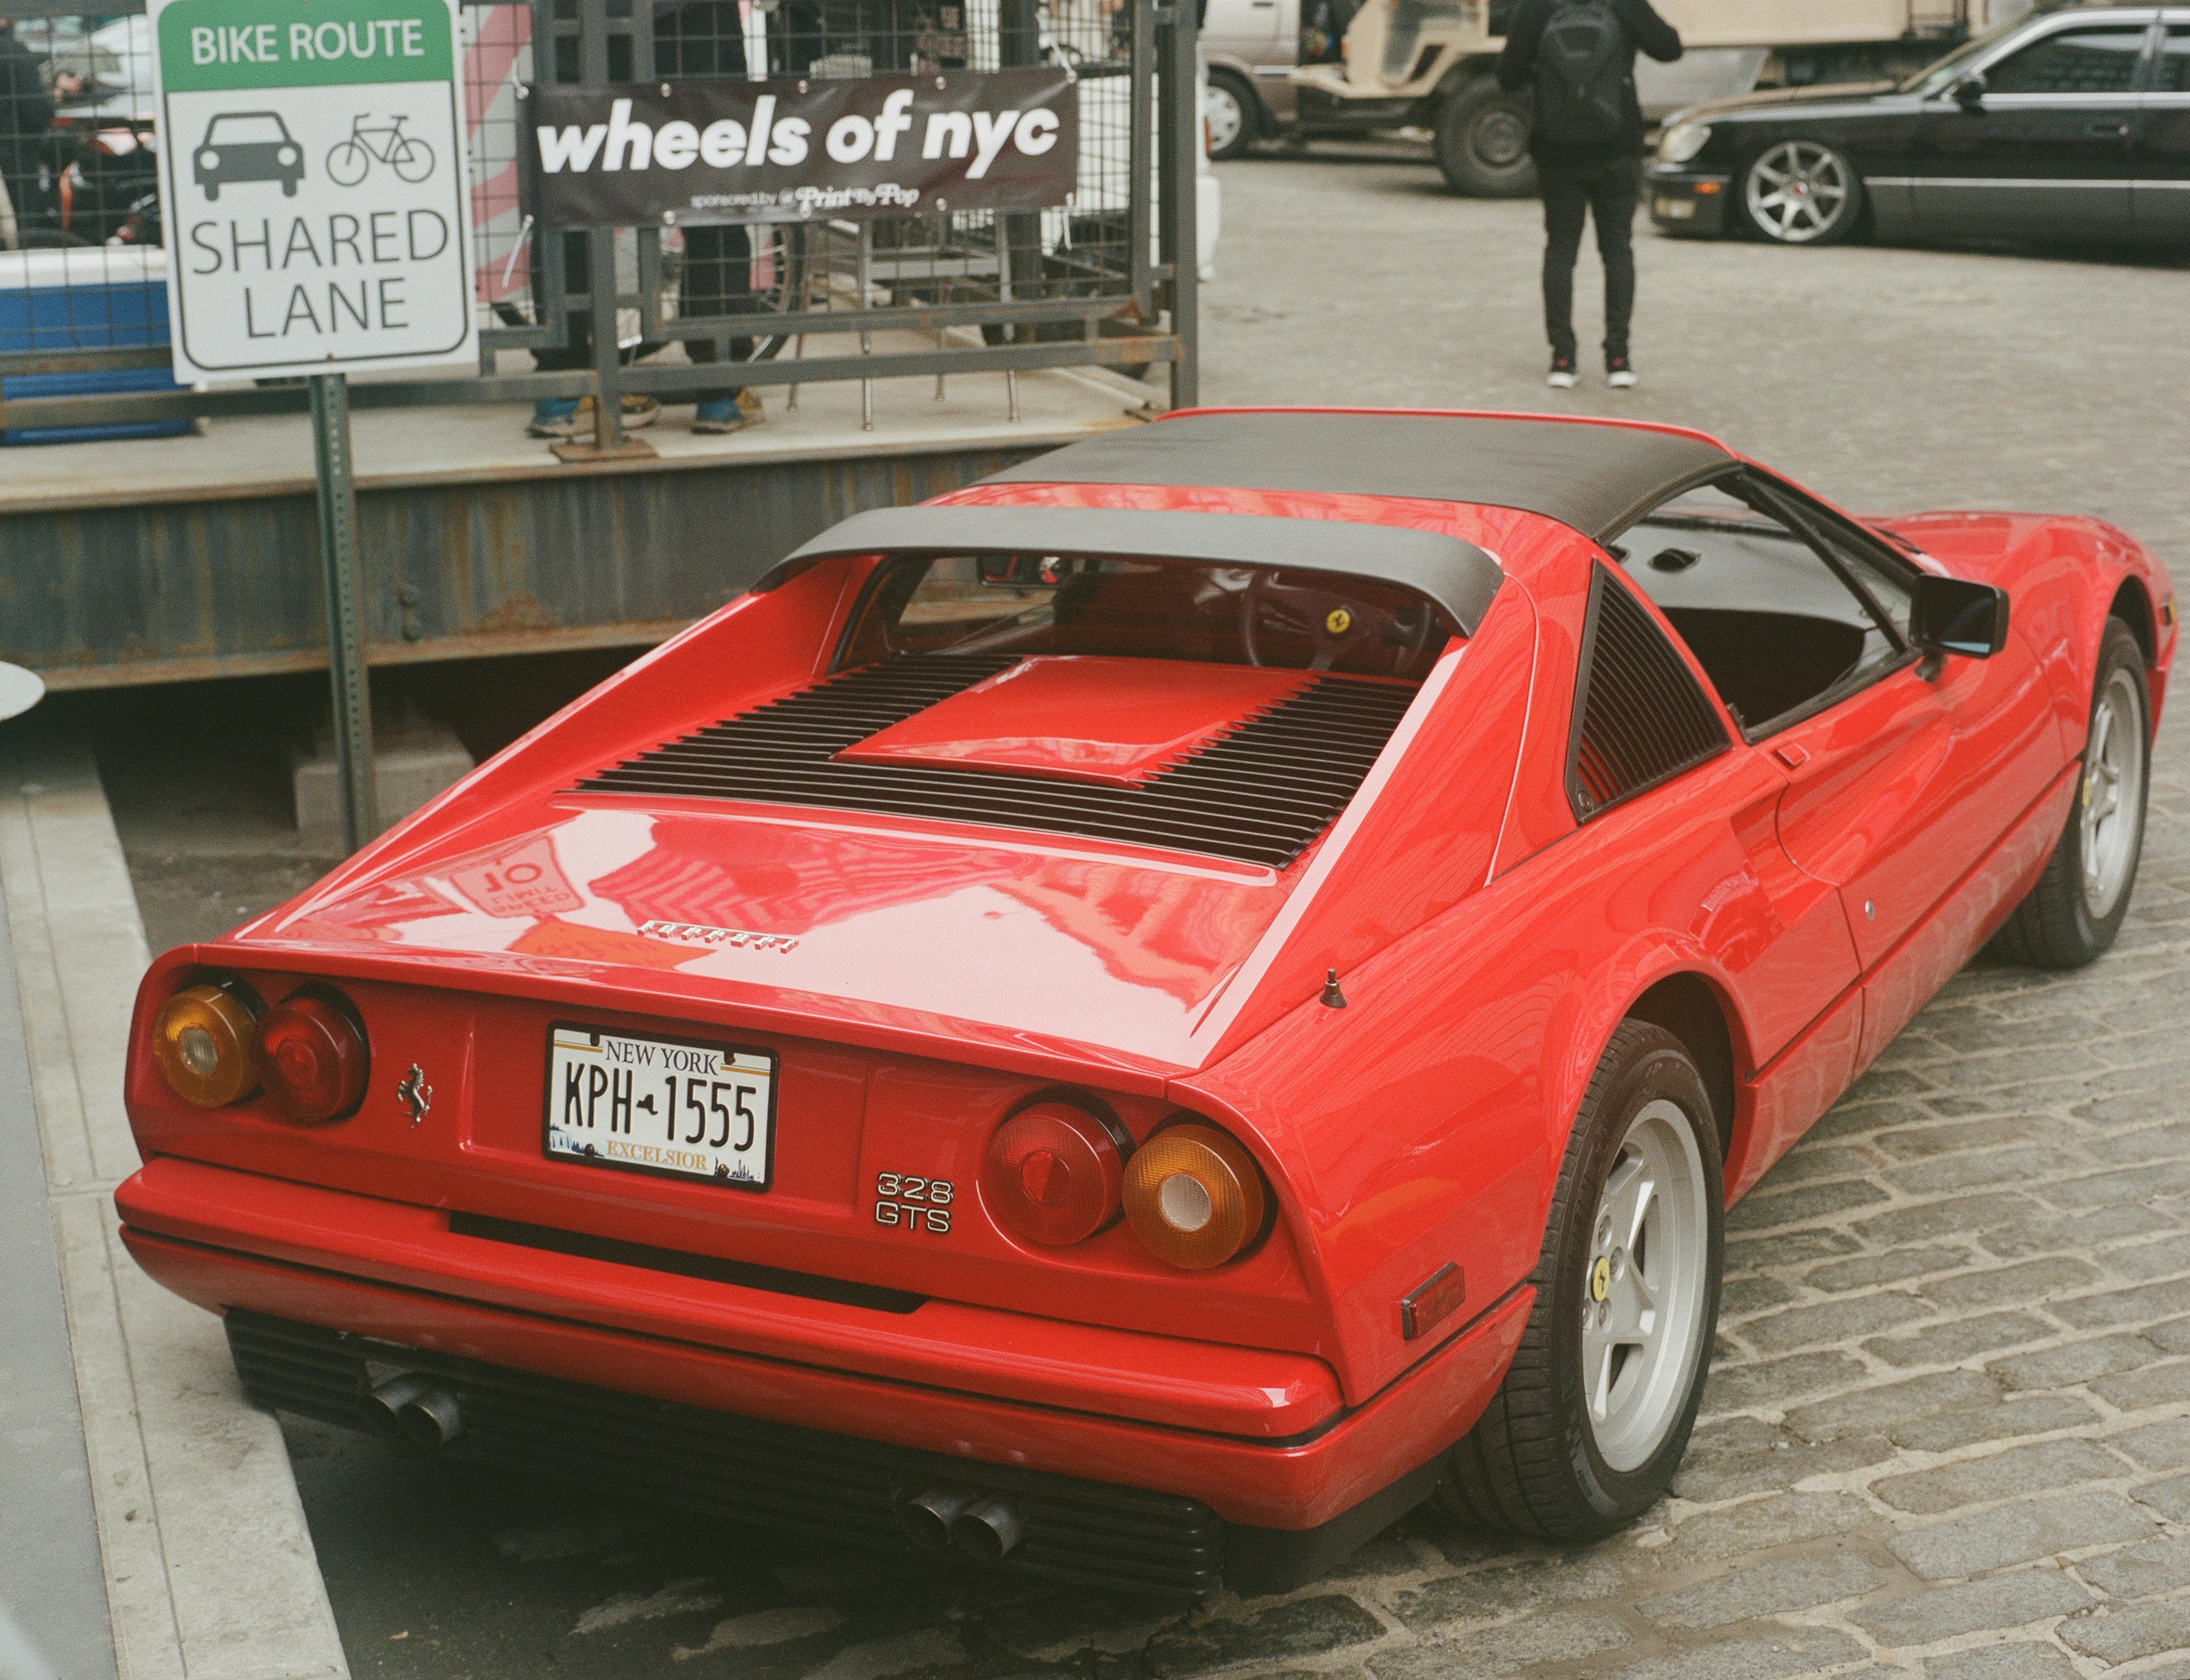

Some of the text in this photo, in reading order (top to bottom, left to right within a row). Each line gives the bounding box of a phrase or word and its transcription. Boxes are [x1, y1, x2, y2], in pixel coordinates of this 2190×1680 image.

[191, 18, 425, 65] BIKE ROUTE
[537, 89, 1060, 179] wheels of nyc
[191, 209, 448, 275] SHARED
[244, 278, 409, 338] LANE
[606, 1040, 719, 1076] NEW YORK
[564, 1061, 757, 1153] KPH 1555
[606, 1139, 708, 1171] EXCELSIOR
[877, 1171, 954, 1204] 328
[875, 1201, 951, 1233] GTS
